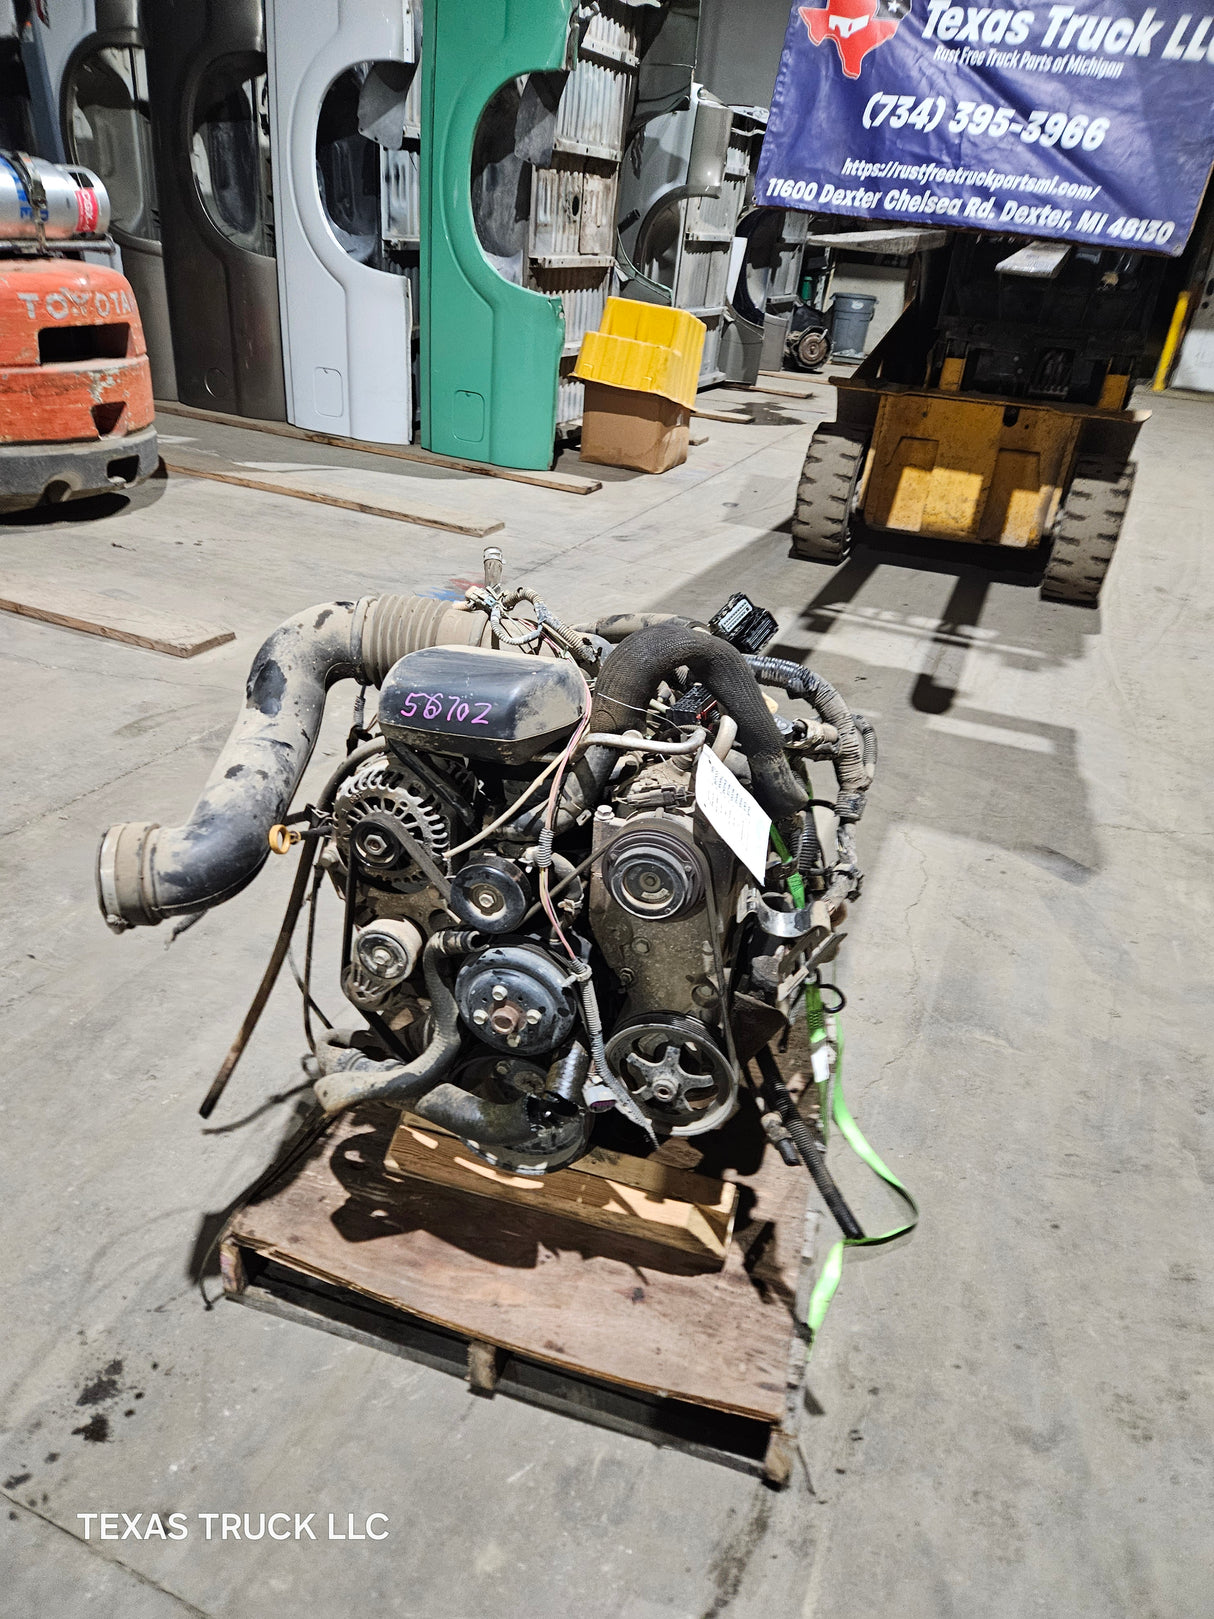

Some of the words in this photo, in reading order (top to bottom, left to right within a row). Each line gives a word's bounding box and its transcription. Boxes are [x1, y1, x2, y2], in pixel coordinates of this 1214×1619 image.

[922, 1, 1035, 46] Texas
[1041, 5, 1166, 57] Truck
[1162, 14, 1214, 65] LL
[933, 45, 961, 64] Rust
[960, 46, 987, 66] Free
[986, 48, 1019, 69] Truck
[1019, 51, 1052, 72] Parts
[1052, 53, 1070, 74] of
[1065, 54, 1125, 80] Michigan
[862, 91, 947, 134] (734)
[949, 101, 1111, 151] 395-3966
[766, 178, 818, 201] 11600
[818, 183, 883, 209] Dexter
[883, 188, 963, 218] Chelsea
[963, 196, 996, 220] Rd.
[1000, 200, 1073, 233] Dexter,
[1075, 209, 1110, 235] MI
[1107, 216, 1176, 246] 48130
[17, 287, 134, 320] TOYOTA
